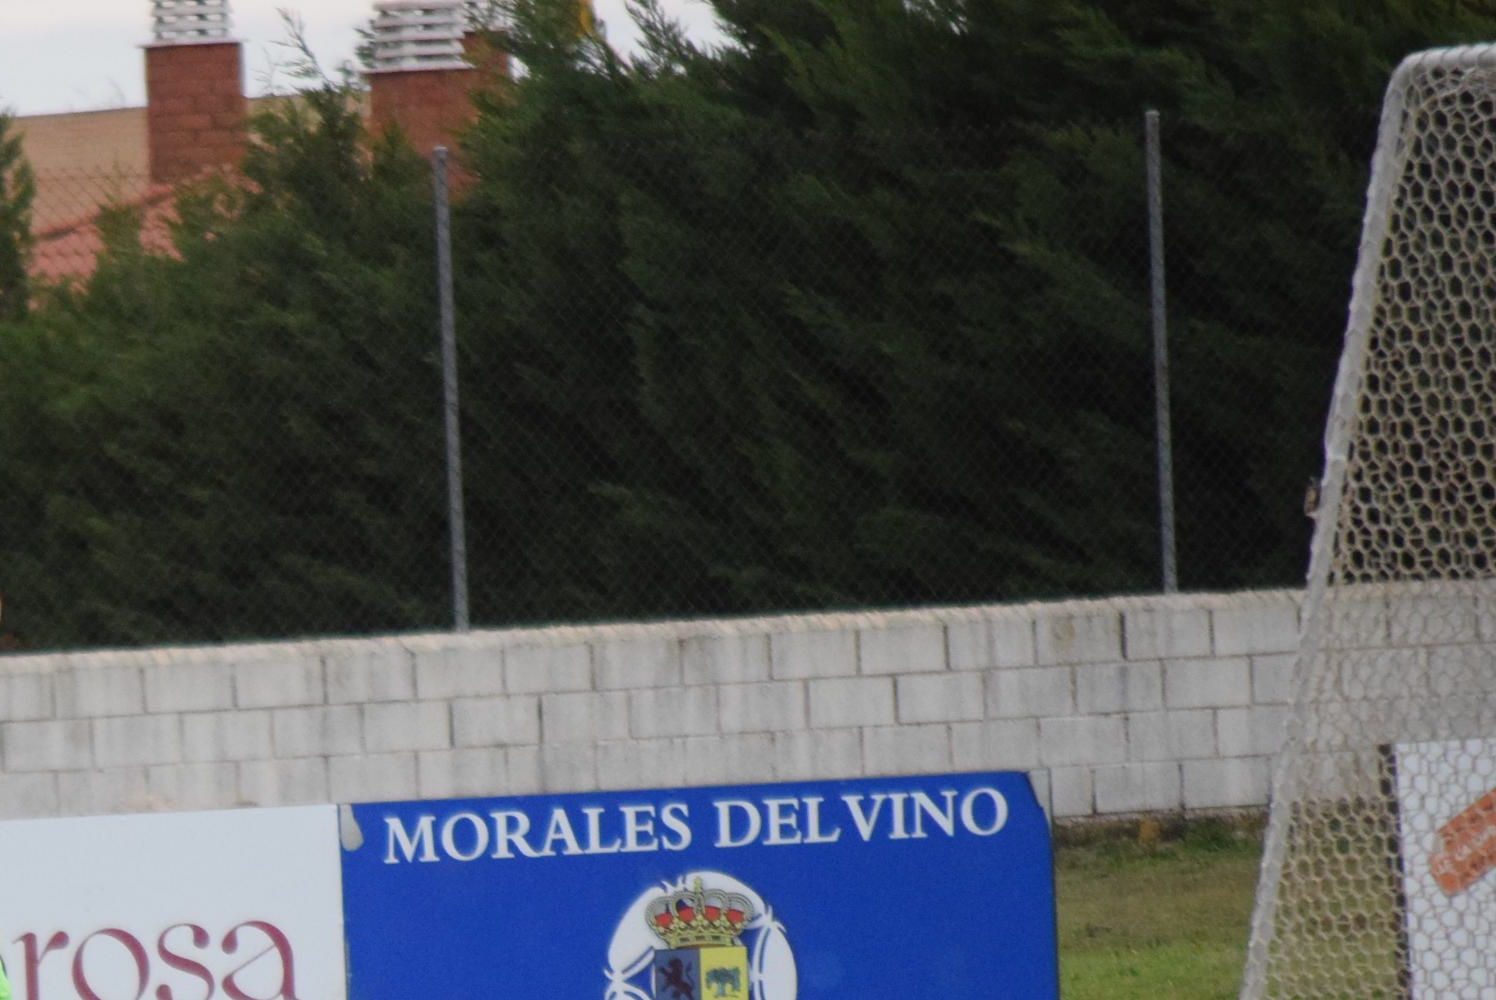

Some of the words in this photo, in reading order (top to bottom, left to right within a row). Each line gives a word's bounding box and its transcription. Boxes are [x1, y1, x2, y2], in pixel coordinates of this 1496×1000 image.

[383, 803, 692, 865] MORALES
[714, 795, 840, 848] DEL
[842, 786, 1009, 842] VINO
